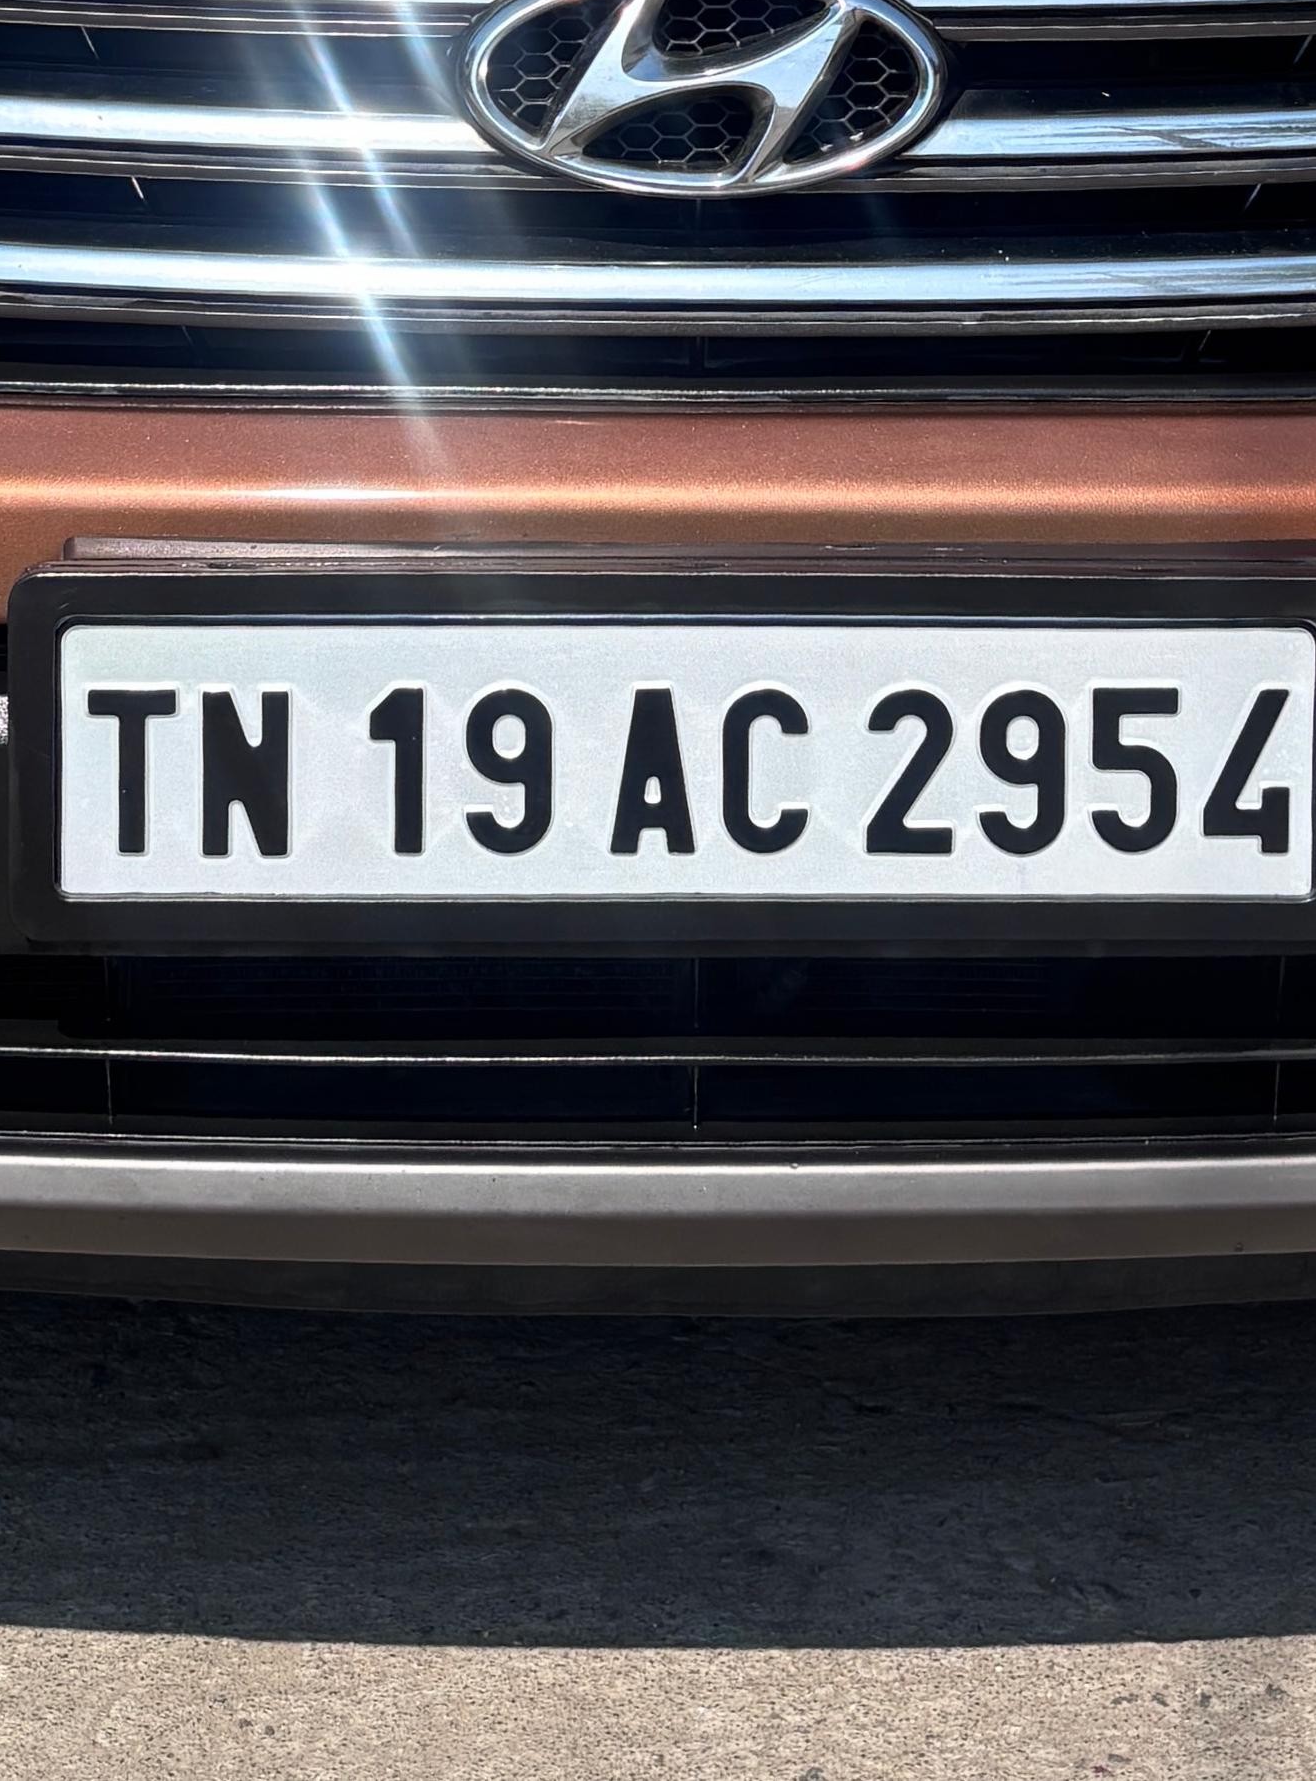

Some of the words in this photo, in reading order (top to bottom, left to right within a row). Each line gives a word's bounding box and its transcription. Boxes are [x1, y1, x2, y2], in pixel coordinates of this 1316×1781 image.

[87, 689, 289, 857] TN
[369, 688, 553, 855] 19
[610, 688, 809, 855] AC
[866, 687, 1290, 856] 2954
